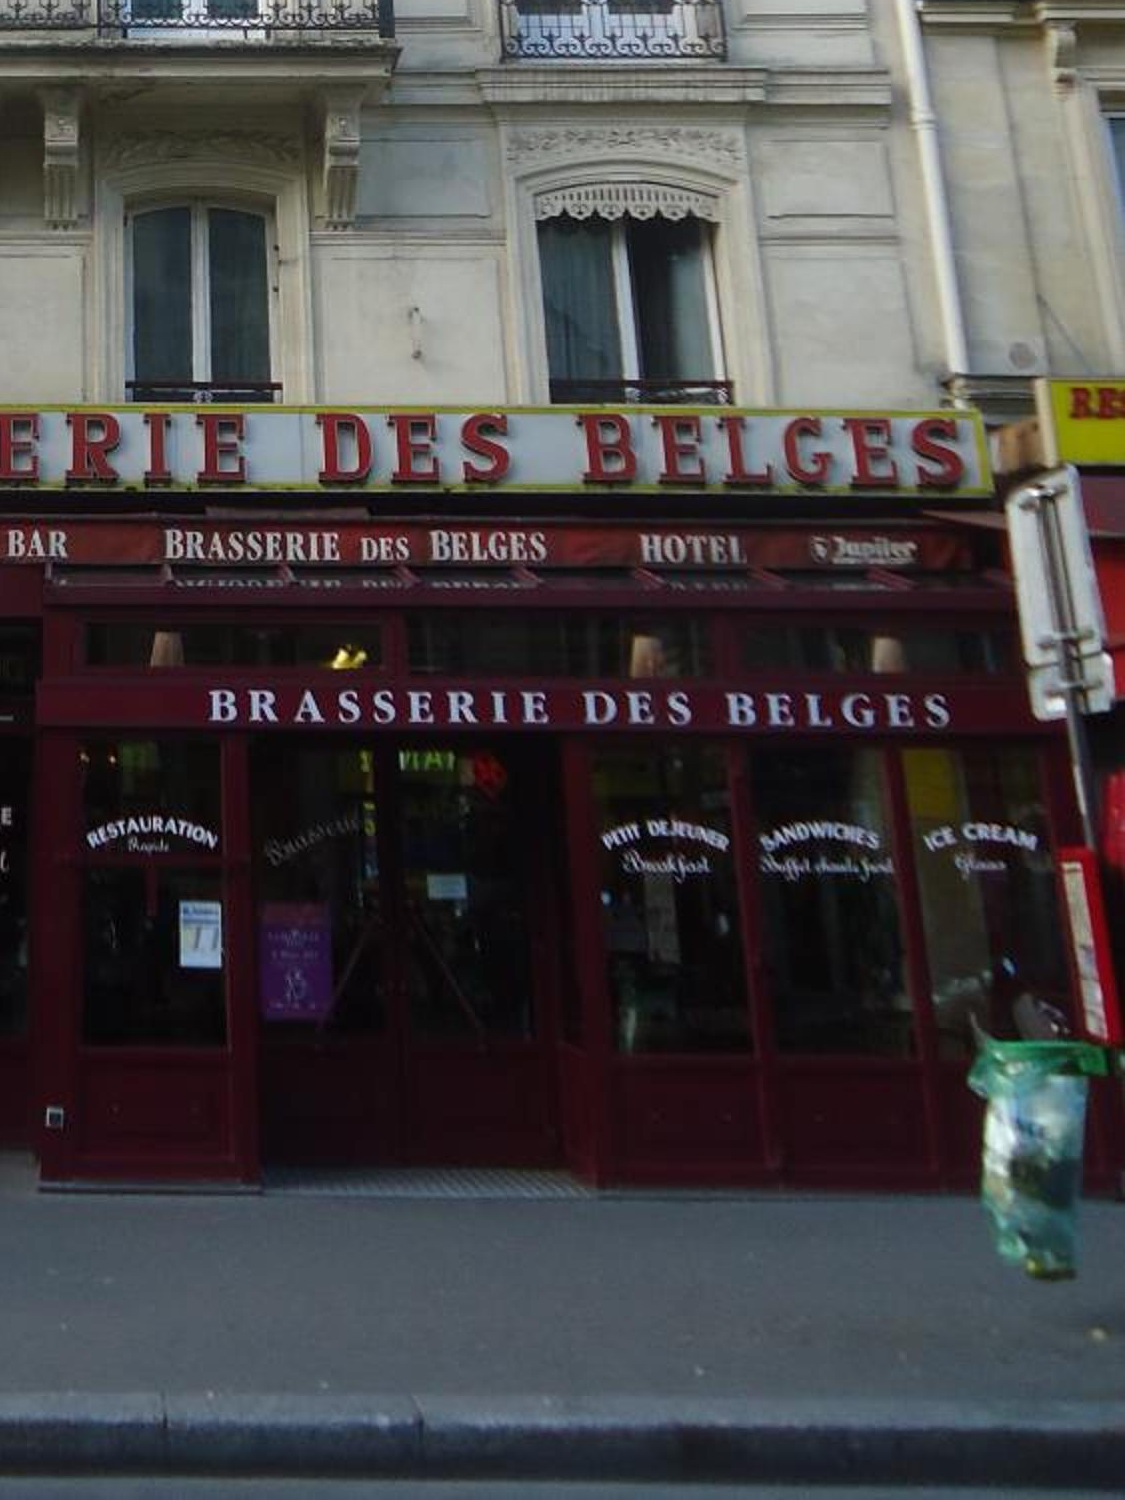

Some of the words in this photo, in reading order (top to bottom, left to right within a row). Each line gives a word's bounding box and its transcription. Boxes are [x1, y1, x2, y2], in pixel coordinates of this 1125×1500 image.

[315, 412, 512, 486] DES
[577, 412, 966, 488] BELGES
[7, 529, 69, 559] BAR
[163, 529, 341, 562] BRASSERIE
[361, 536, 411, 563] DES
[429, 530, 548, 563] BELGES
[640, 533, 748, 565] HOTEL
[208, 689, 550, 725] BRASSERIE
[583, 690, 693, 726] DES
[727, 692, 952, 729] BELGES
[85, 815, 219, 850] RESTAURATION
[601, 822, 642, 851] PETIT
[759, 821, 881, 851] SANDWICHES
[922, 825, 957, 852] ICE
[960, 821, 1038, 852] CREAM
